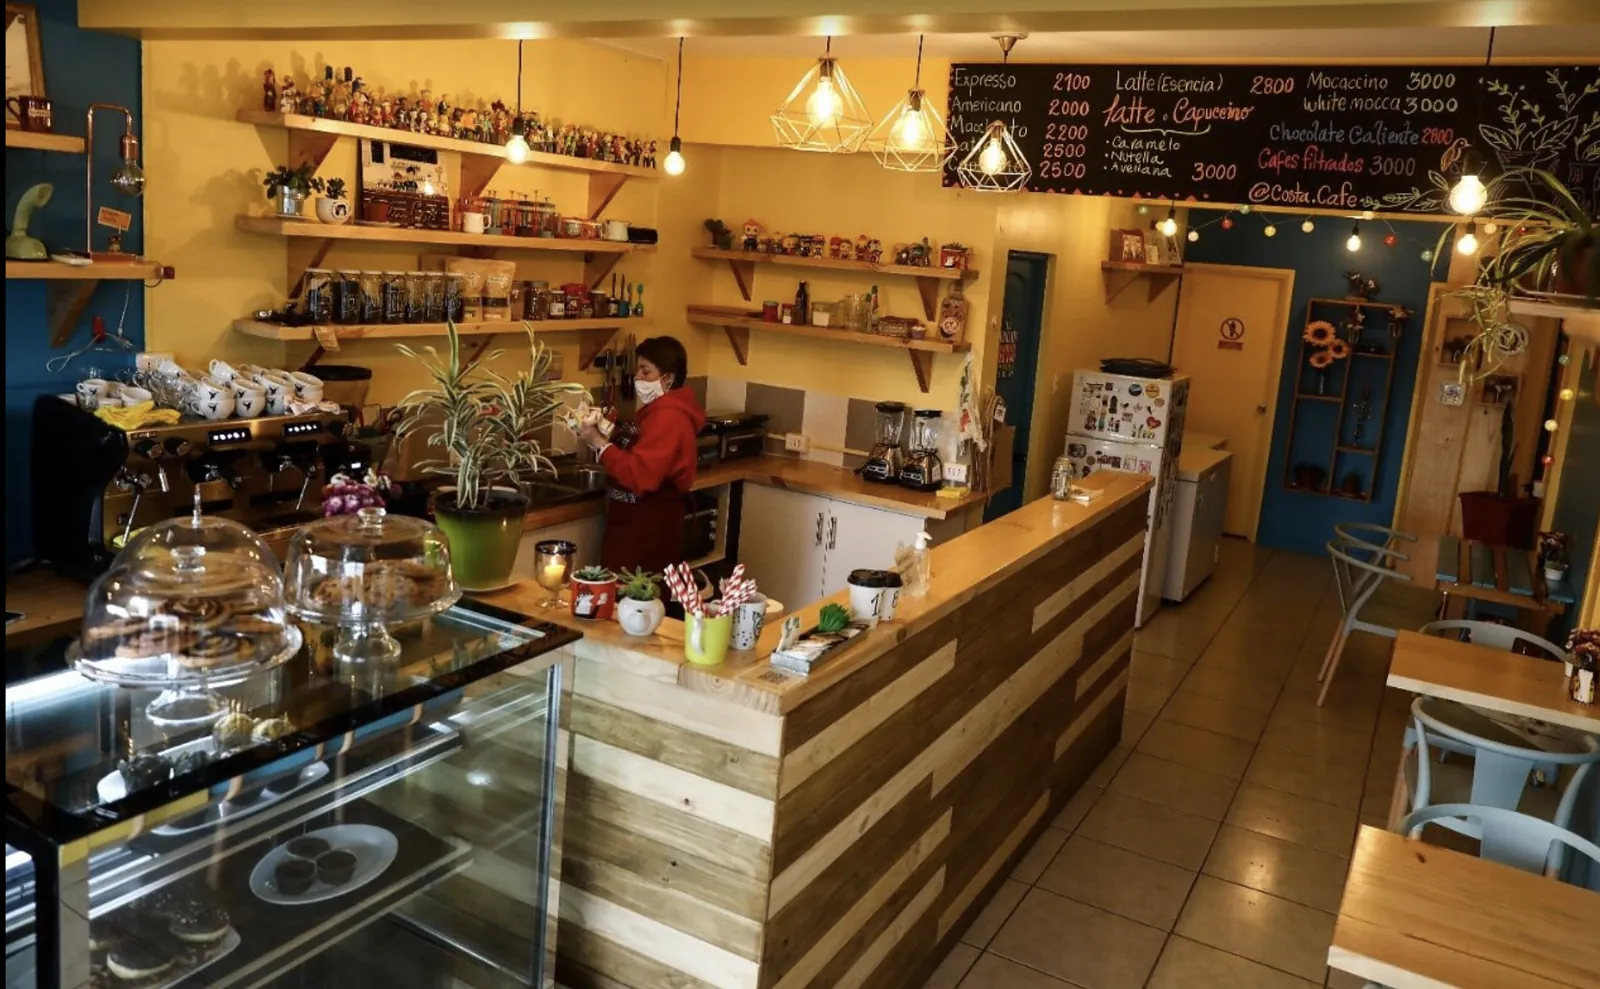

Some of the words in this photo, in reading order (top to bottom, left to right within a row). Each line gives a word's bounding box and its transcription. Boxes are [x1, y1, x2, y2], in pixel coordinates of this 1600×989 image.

[955, 68, 1017, 96] Expresso
[1053, 72, 1090, 91] 2100
[1115, 70, 1156, 91] Latte
[1250, 75, 1295, 95] 2800
[1306, 71, 1388, 91] Mocaccino
[1406, 71, 1456, 91] 3000
[952, 95, 1022, 113] Americano
[1049, 99, 1089, 116] 2000
[1403, 97, 1459, 115] 3000
[1045, 123, 1088, 141] 2200
[1270, 120, 1345, 143] Chocolate
[1350, 120, 1420, 144] Caliente
[1421, 127, 1454, 144] 2800
[1043, 142, 1086, 158] 2500
[1112, 135, 1180, 151] Caramelo
[1039, 160, 1086, 179] 2500
[1110, 162, 1172, 178] Avellana
[1191, 162, 1237, 181] 3000
[1369, 155, 1416, 177] 3000
[1248, 181, 1358, 208] @Costa.Cafe
